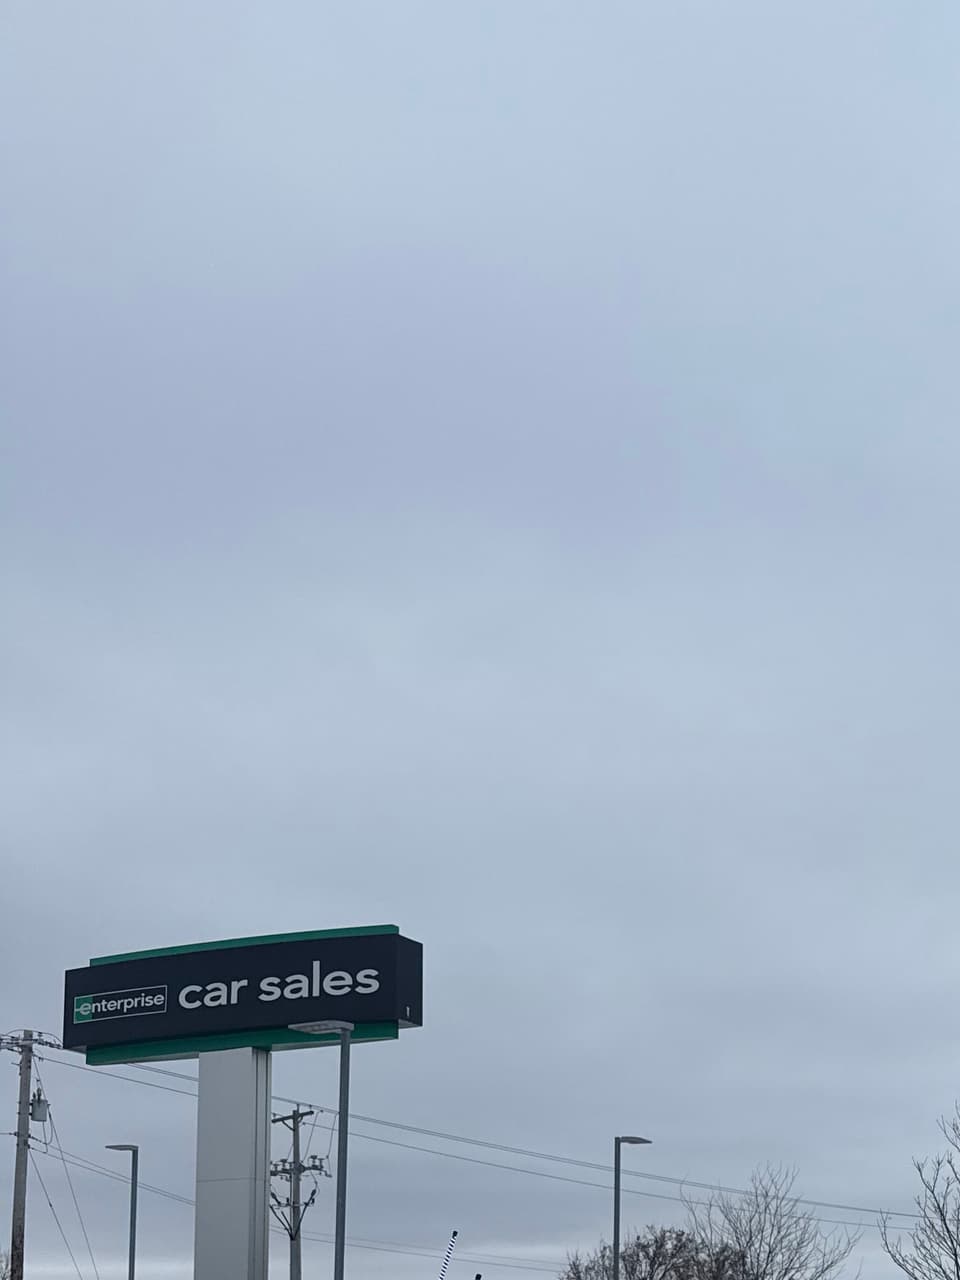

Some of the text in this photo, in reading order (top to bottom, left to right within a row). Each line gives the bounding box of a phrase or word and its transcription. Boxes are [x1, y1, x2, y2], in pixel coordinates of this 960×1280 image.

[77, 960, 380, 1017] enterprise car sales
